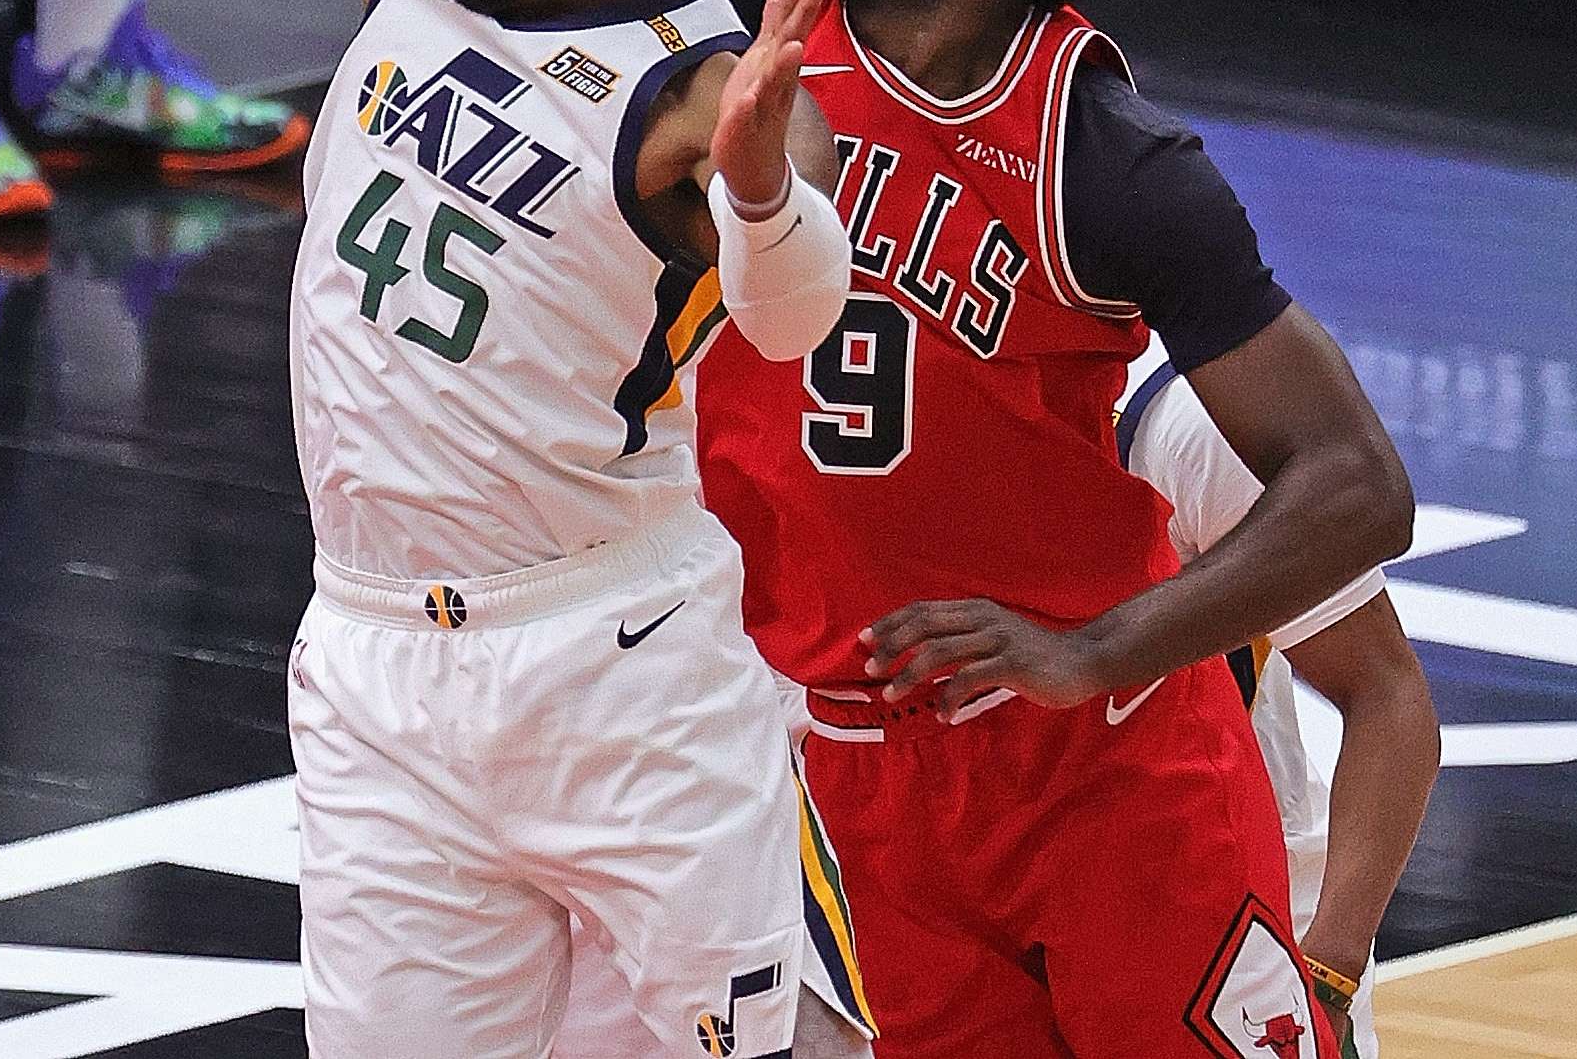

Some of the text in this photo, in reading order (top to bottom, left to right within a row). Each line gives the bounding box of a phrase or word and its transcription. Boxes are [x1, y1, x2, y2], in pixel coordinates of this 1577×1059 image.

[547, 51, 582, 76] 5
[563, 73, 609, 101] FIGHT
[646, 14, 687, 54] 1223
[357, 46, 582, 240] JAZZ
[336, 168, 508, 363] 45
[801, 290, 918, 475] 9
